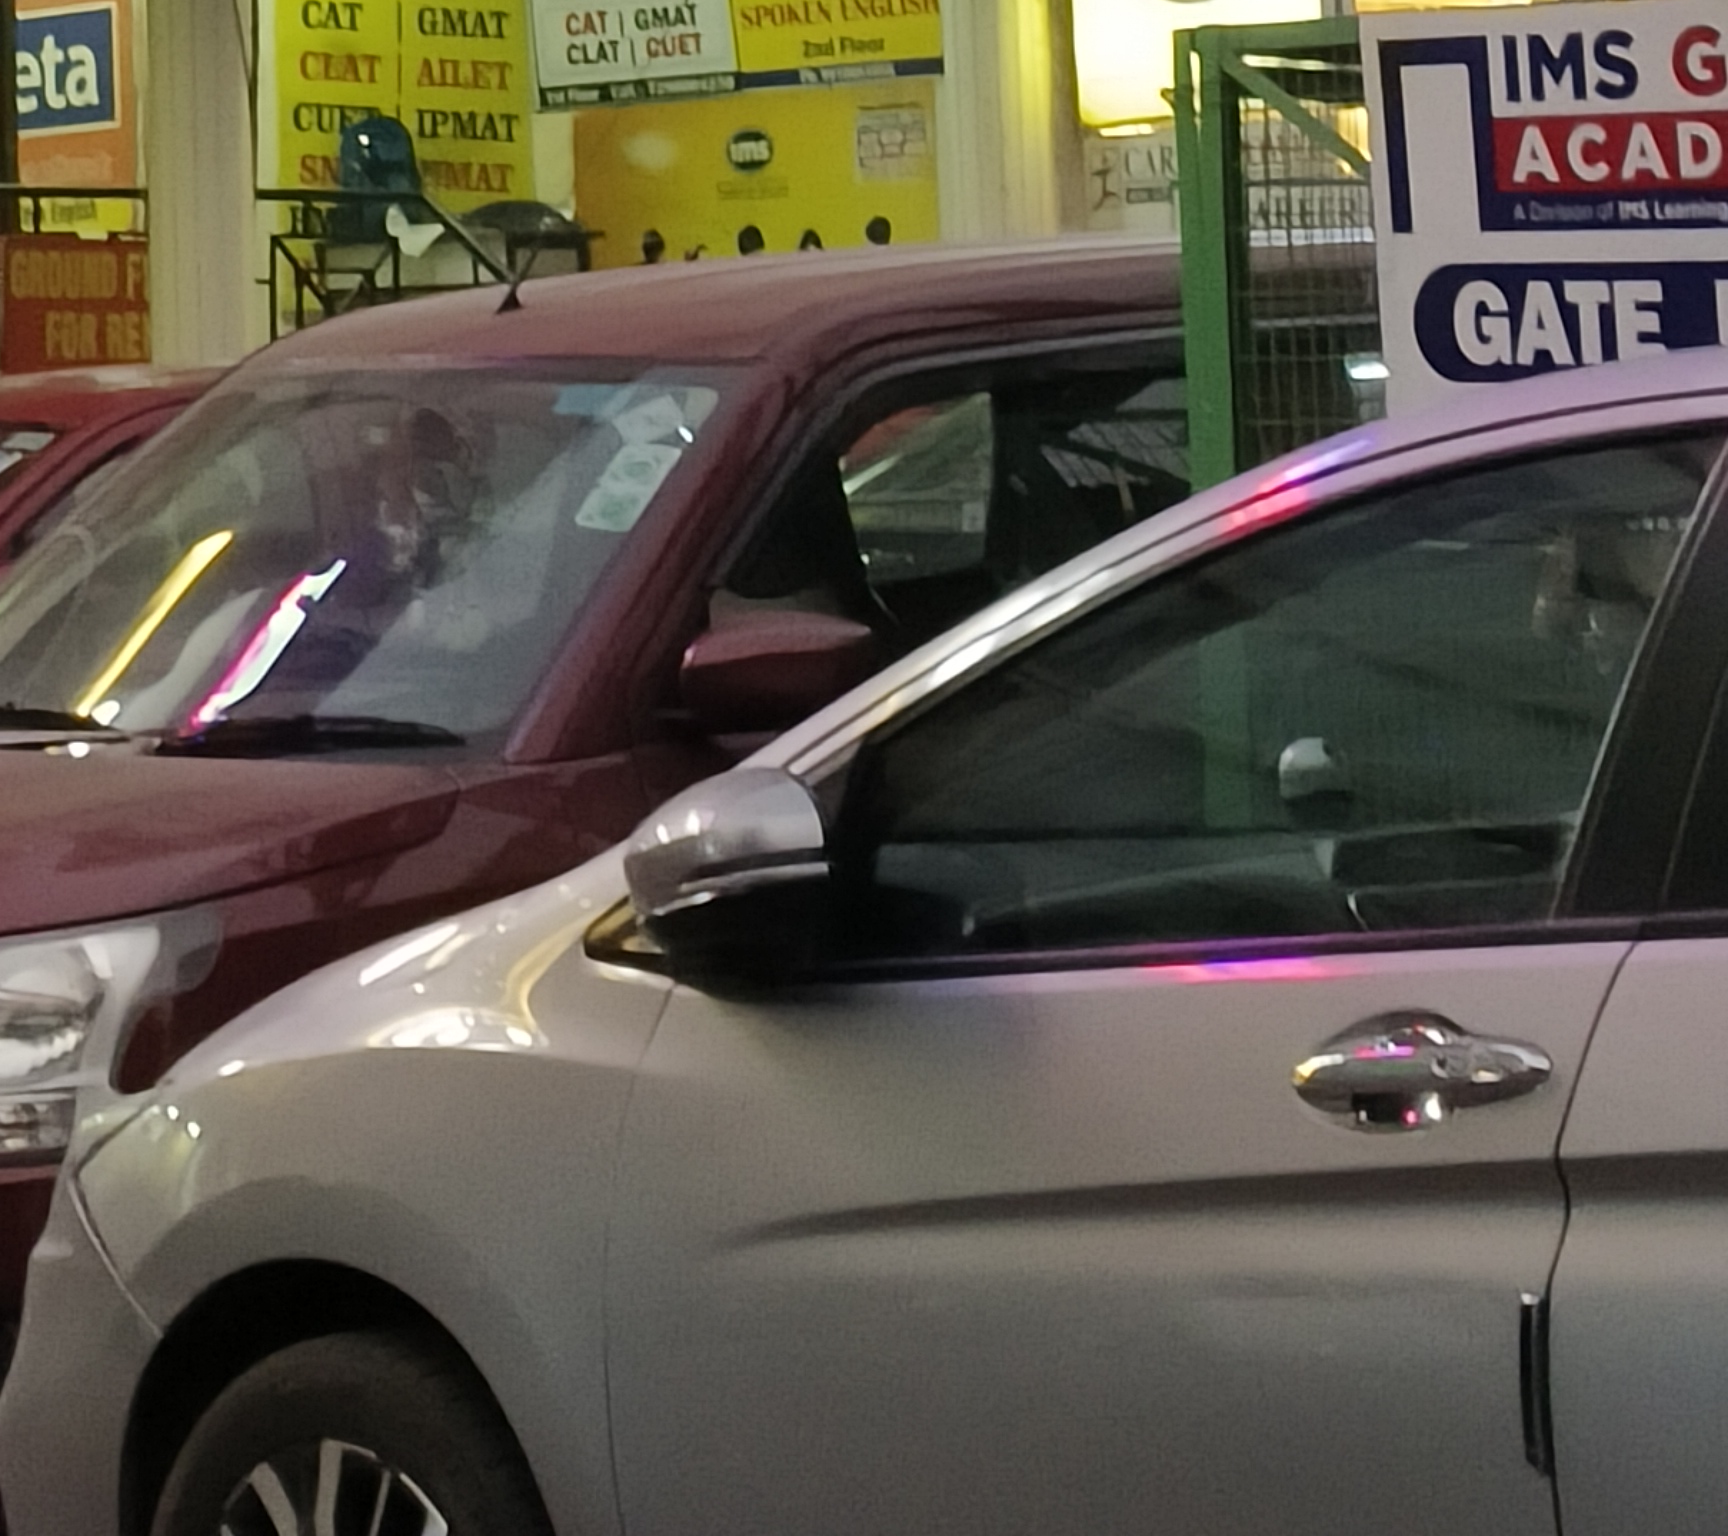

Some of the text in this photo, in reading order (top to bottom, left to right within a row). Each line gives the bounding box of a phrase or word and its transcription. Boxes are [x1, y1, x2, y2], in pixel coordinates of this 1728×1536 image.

[302, 0, 510, 39] CAT GMAT
[566, 3, 697, 36] CAT GMAT
[740, 0, 831, 30] SPOKEN
[566, 32, 702, 64] CLAT CUET
[1502, 30, 1639, 102] IMS
[300, 51, 381, 84] CLAT
[417, 58, 513, 91] AILET
[417, 109, 520, 142] IPMAT
[1512, 121, 1723, 184] ACAD
[1453, 279, 1668, 367] GATE
